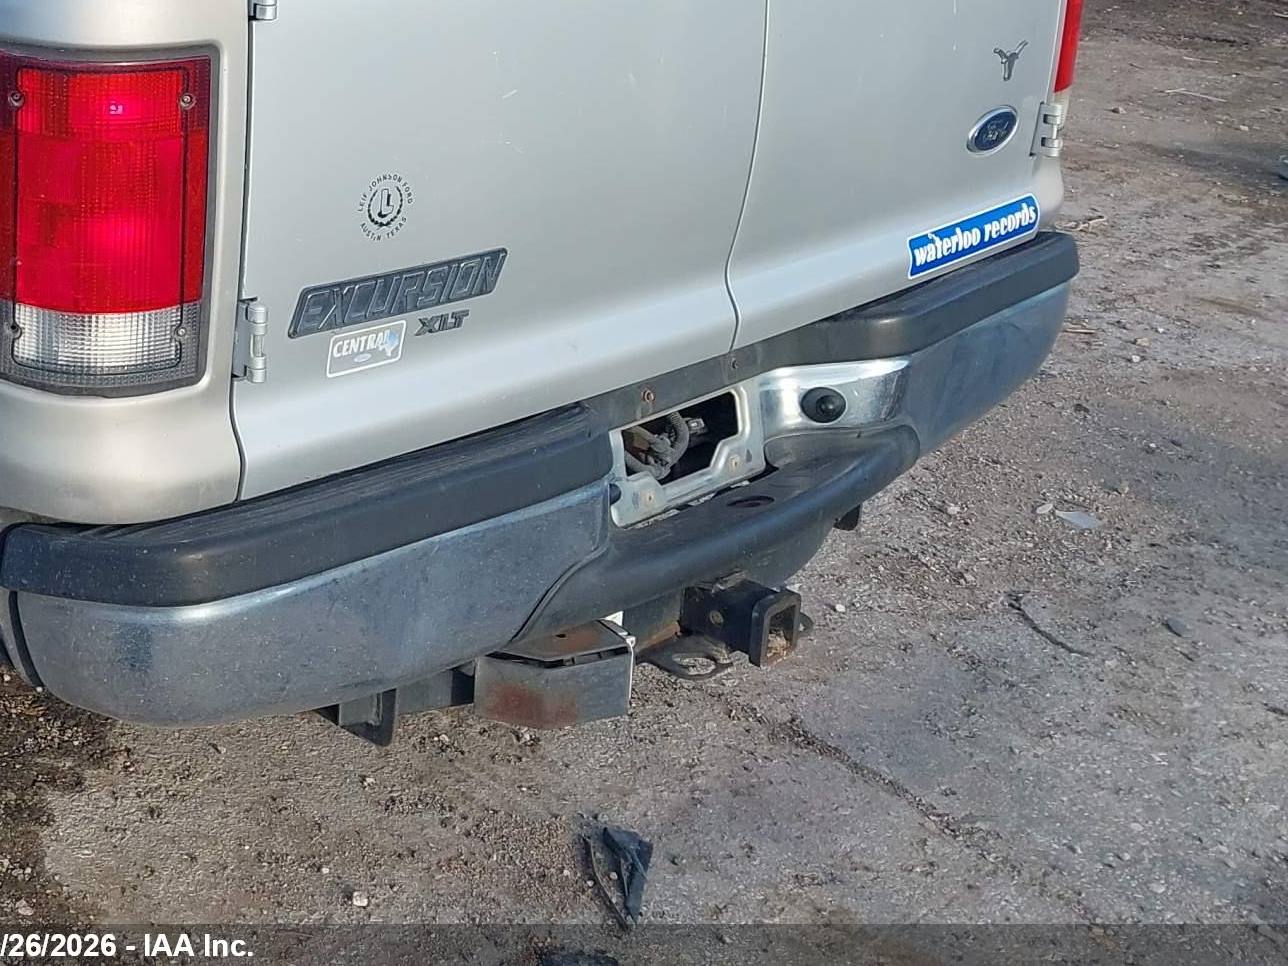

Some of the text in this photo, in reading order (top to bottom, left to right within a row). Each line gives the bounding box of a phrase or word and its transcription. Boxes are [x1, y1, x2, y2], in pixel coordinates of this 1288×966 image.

[368, 173, 403, 192] JOHNSON
[402, 182, 413, 204] FORD
[360, 216, 407, 242] AUSTIN TEXAS
[914, 202, 1037, 267] waterloo records
[295, 252, 507, 332] EXCURSION
[414, 309, 470, 337] XLT
